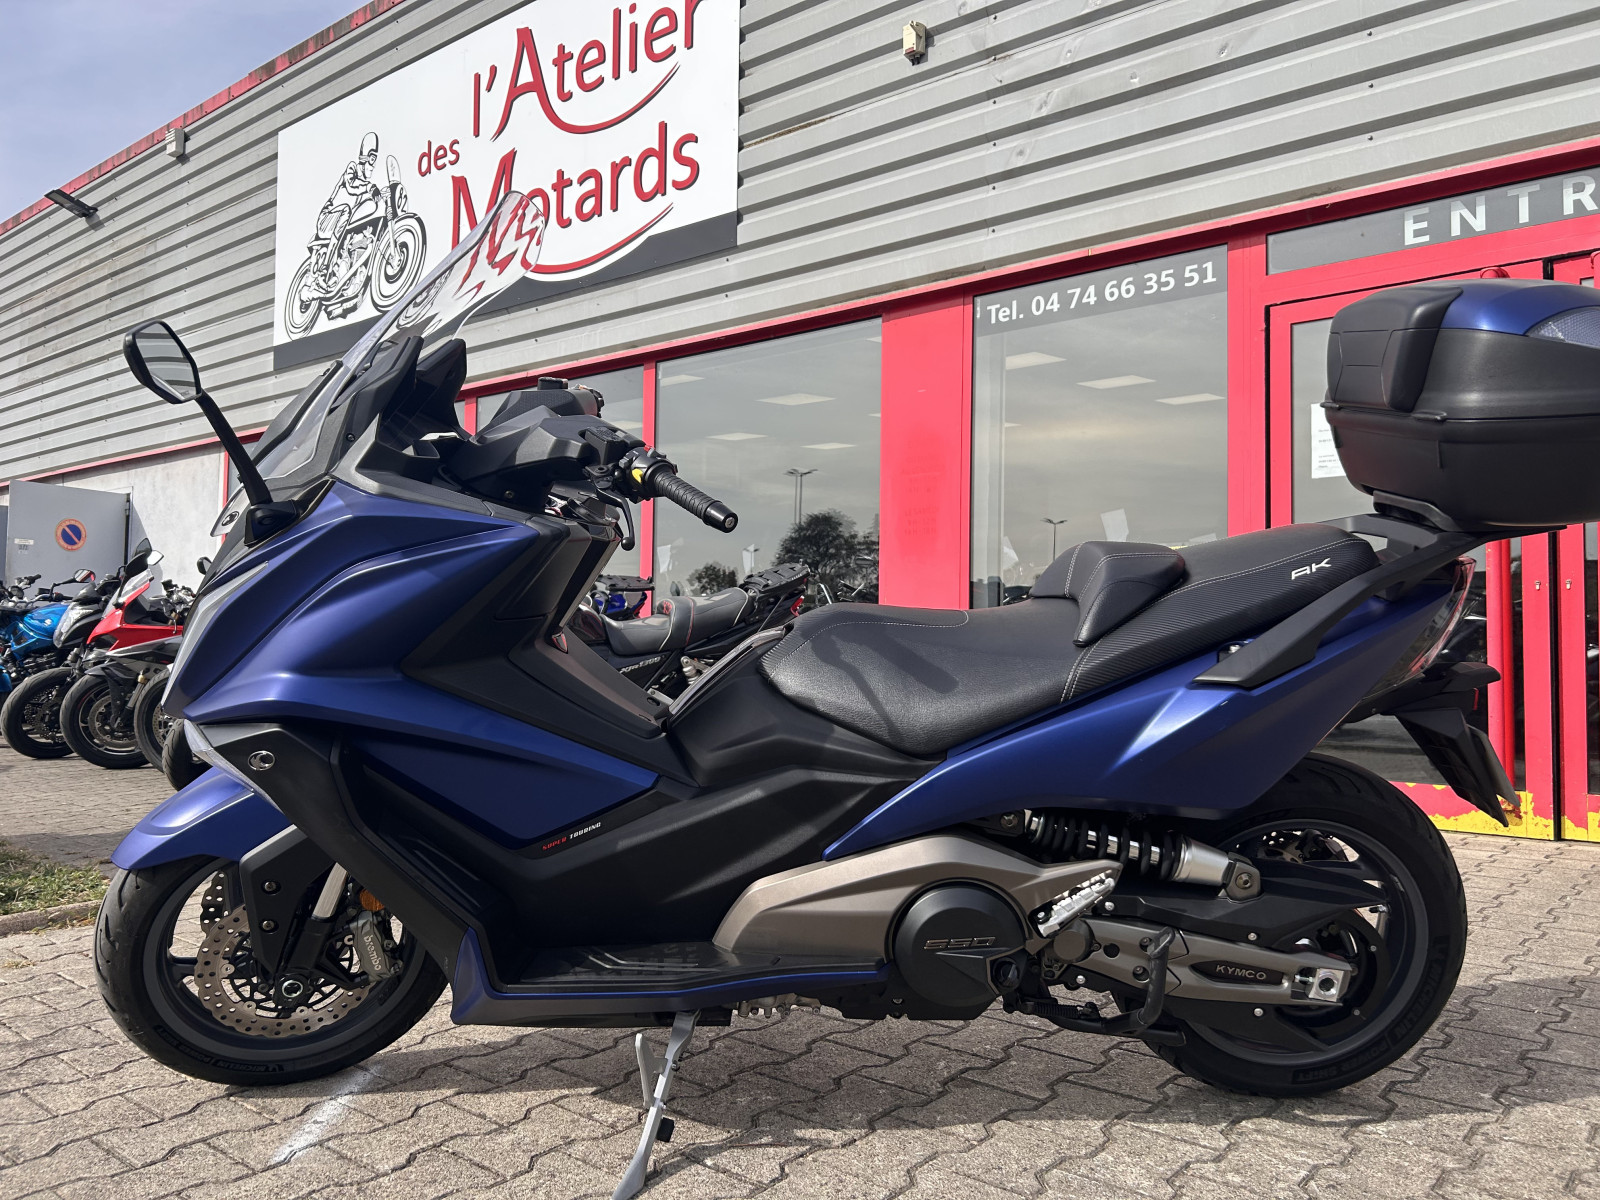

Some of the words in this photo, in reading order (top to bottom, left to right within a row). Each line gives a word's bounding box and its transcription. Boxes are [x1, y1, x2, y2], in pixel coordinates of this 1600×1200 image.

[473, 0, 702, 141] l'Atelier
[417, 136, 461, 177] des
[1404, 175, 1599, 246] ENTR
[987, 300, 1024, 324] Tel.
[1031, 292, 1060, 315] 04
[1067, 284, 1097, 309] 74
[1104, 277, 1136, 302] 66
[1143, 269, 1176, 294] 35
[1184, 261, 1217, 287] 51
[1291, 558, 1332, 580] AK
[569, 821, 601, 839] TOURING
[363, 934, 382, 971] brembo
[1216, 964, 1267, 980] KYMCO
